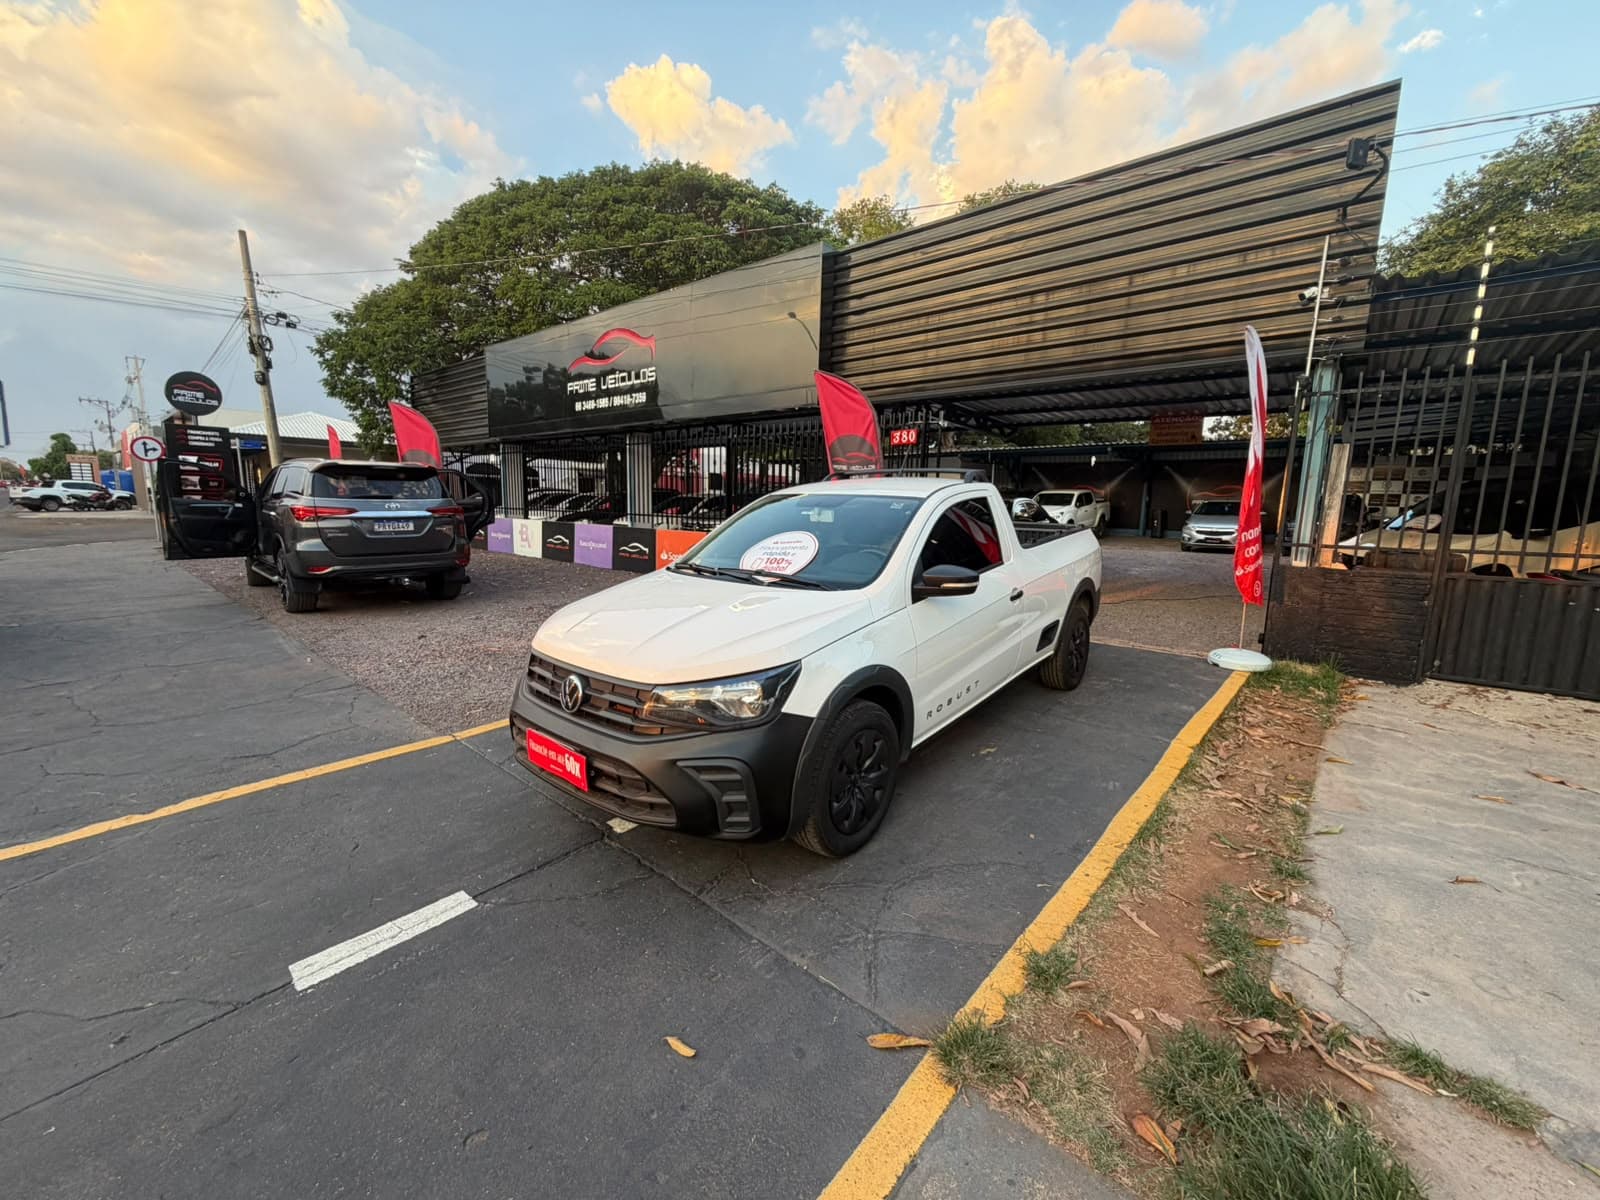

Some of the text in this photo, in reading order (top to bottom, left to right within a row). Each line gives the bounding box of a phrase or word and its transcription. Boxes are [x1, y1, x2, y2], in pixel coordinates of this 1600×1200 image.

[567, 378, 597, 395] PRIME
[892, 431, 916, 443] 380
[764, 557, 792, 566] 100%
[926, 679, 980, 720] ROBUST
